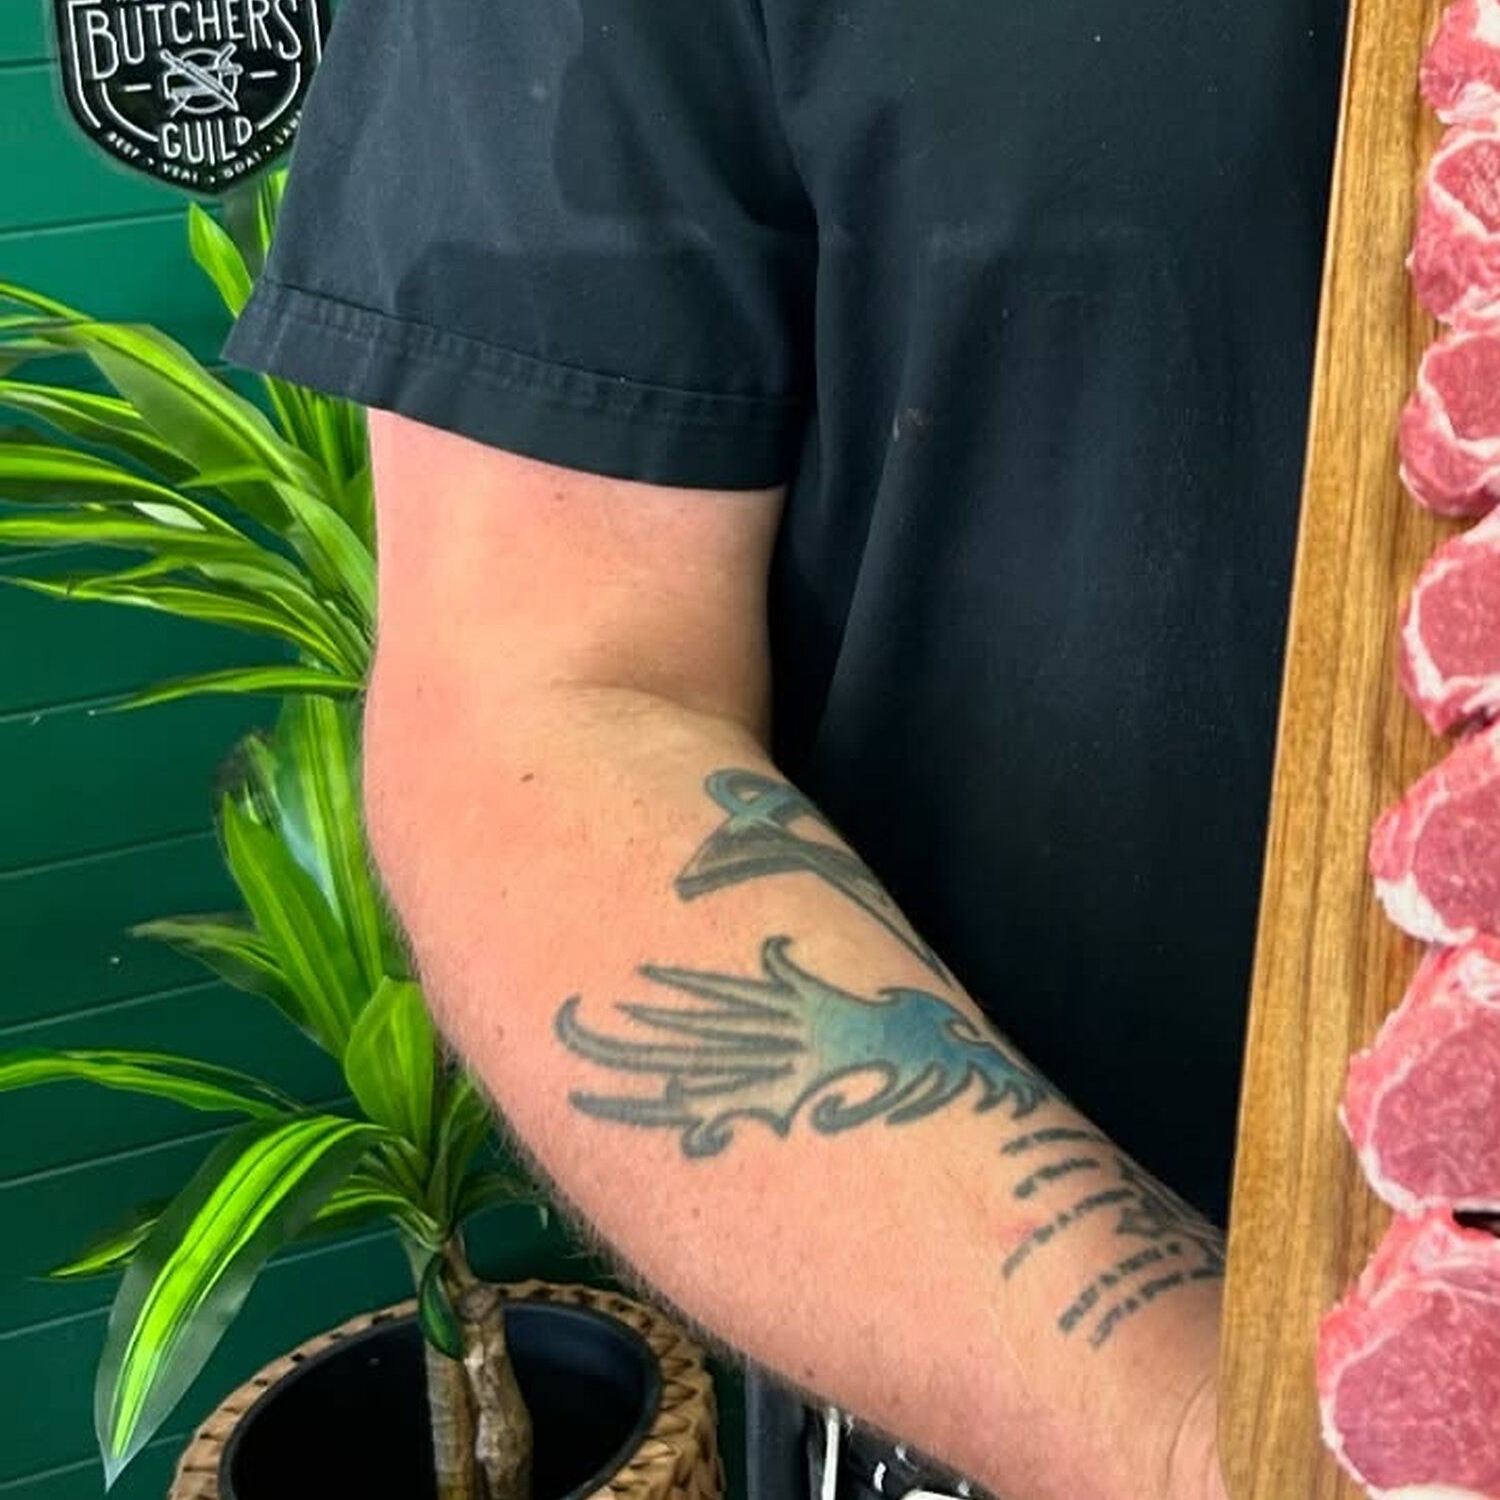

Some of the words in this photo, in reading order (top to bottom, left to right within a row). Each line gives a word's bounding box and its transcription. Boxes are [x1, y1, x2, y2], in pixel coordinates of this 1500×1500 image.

[107, 130, 141, 158] BEEF
[162, 162, 199, 184] VEAL
[161, 116, 253, 166] GUILD
